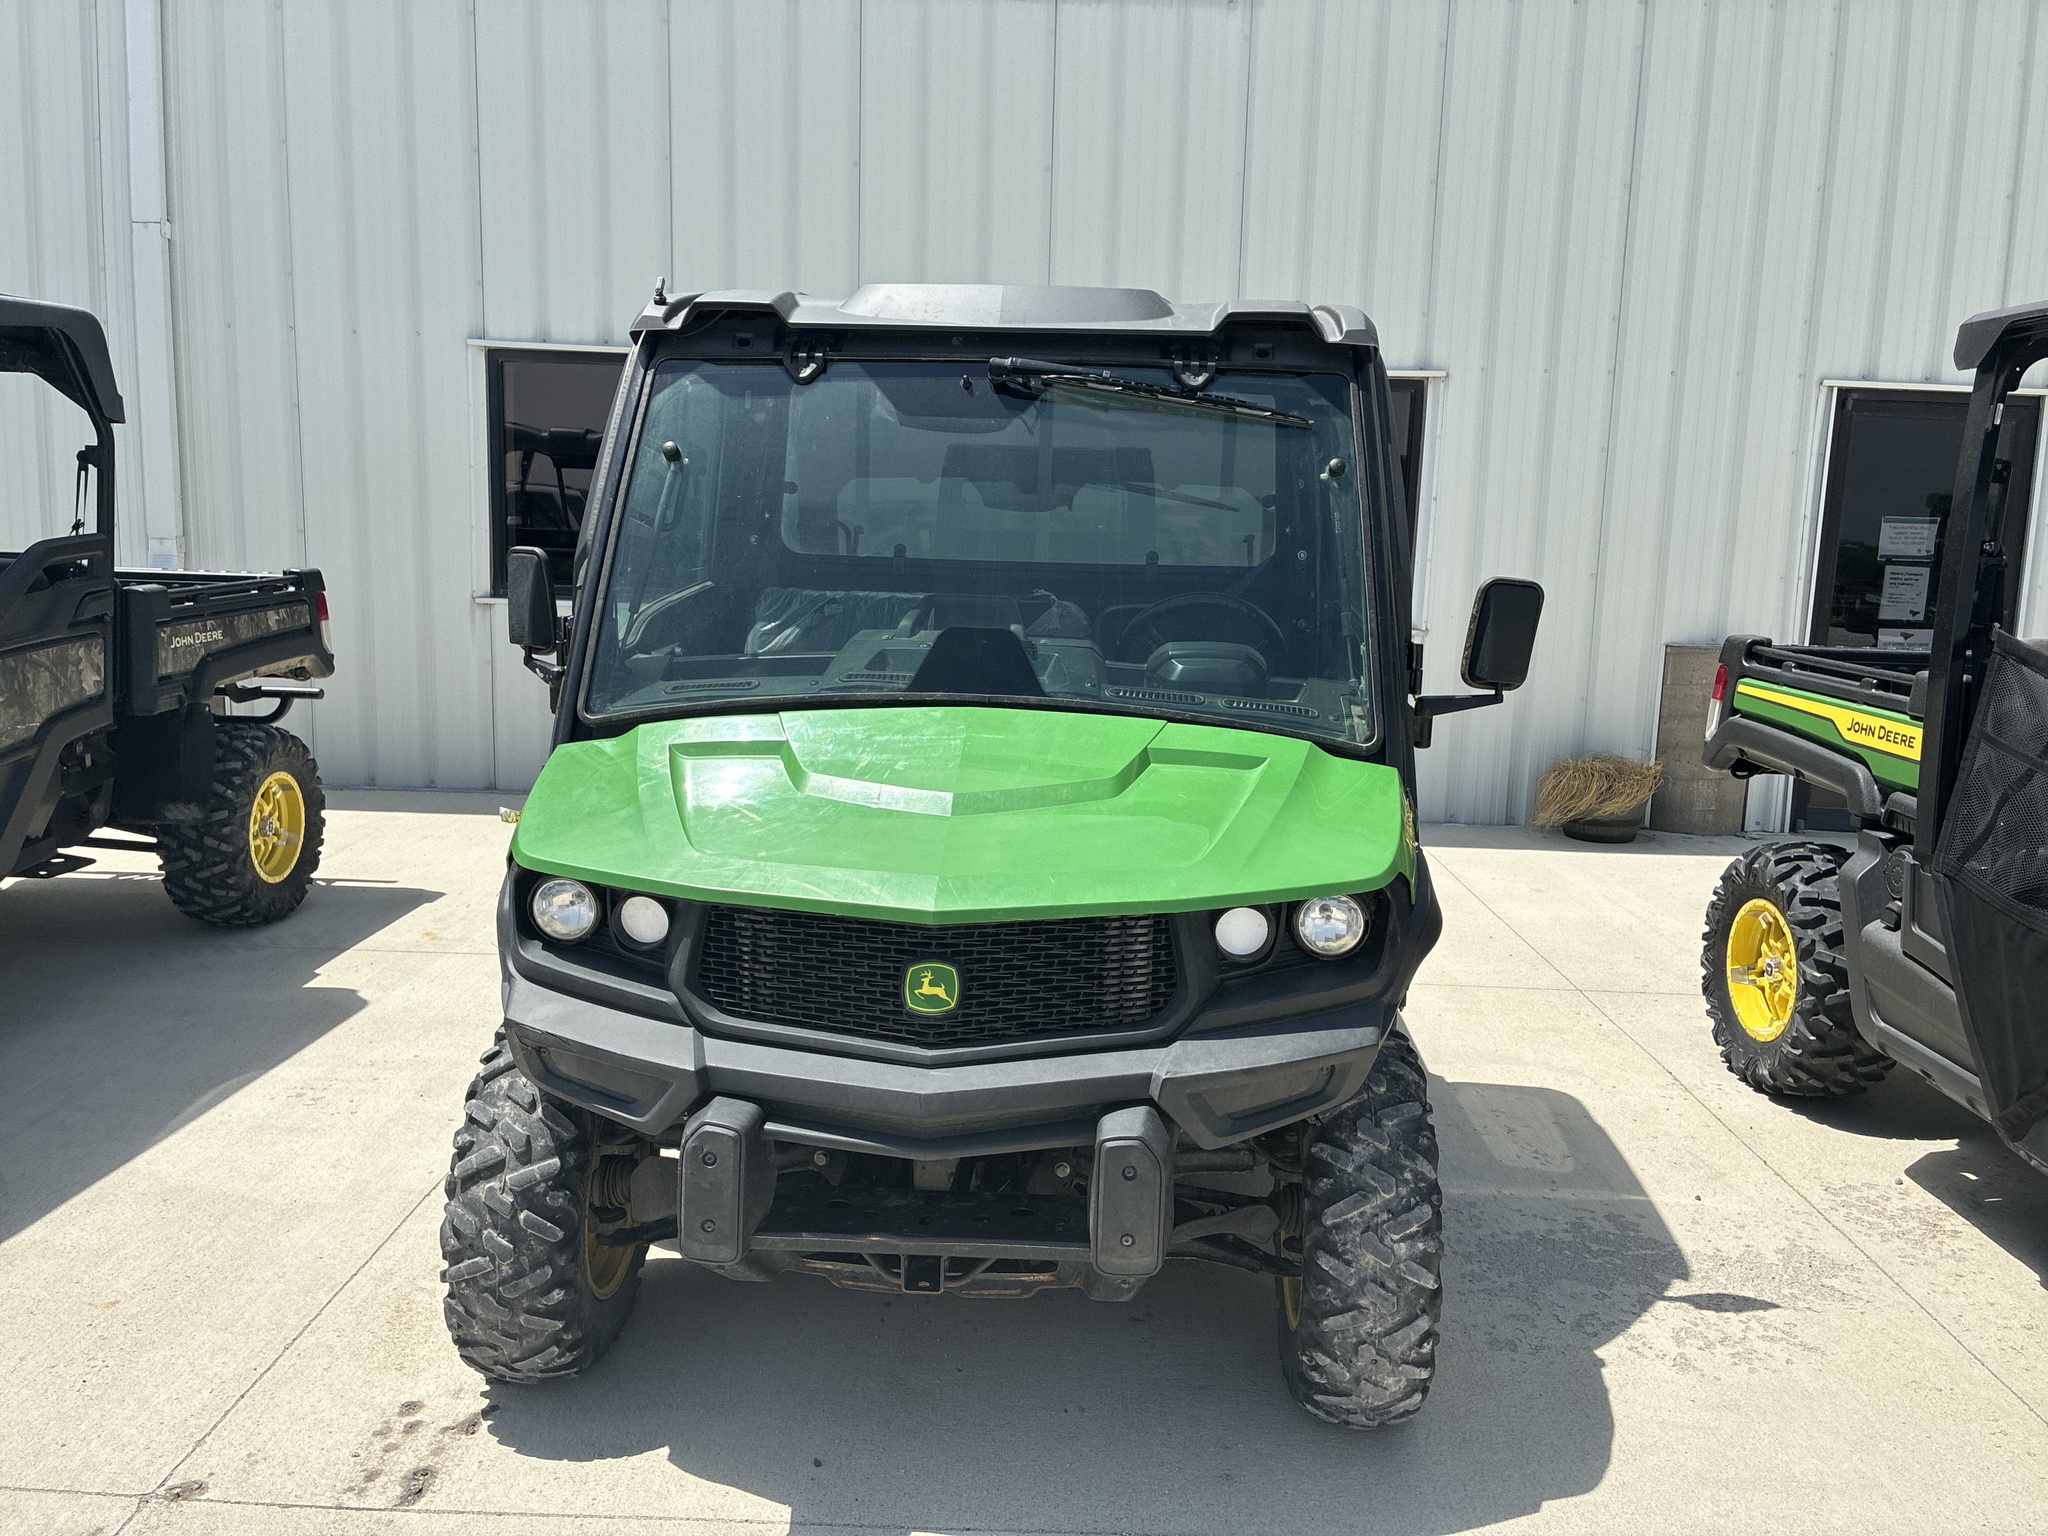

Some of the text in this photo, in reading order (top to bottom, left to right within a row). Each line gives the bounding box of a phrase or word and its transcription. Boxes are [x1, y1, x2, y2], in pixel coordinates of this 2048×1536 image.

[170, 630, 223, 648] JOHN DEERE
[1847, 718, 1915, 749] JOHN DEERE
